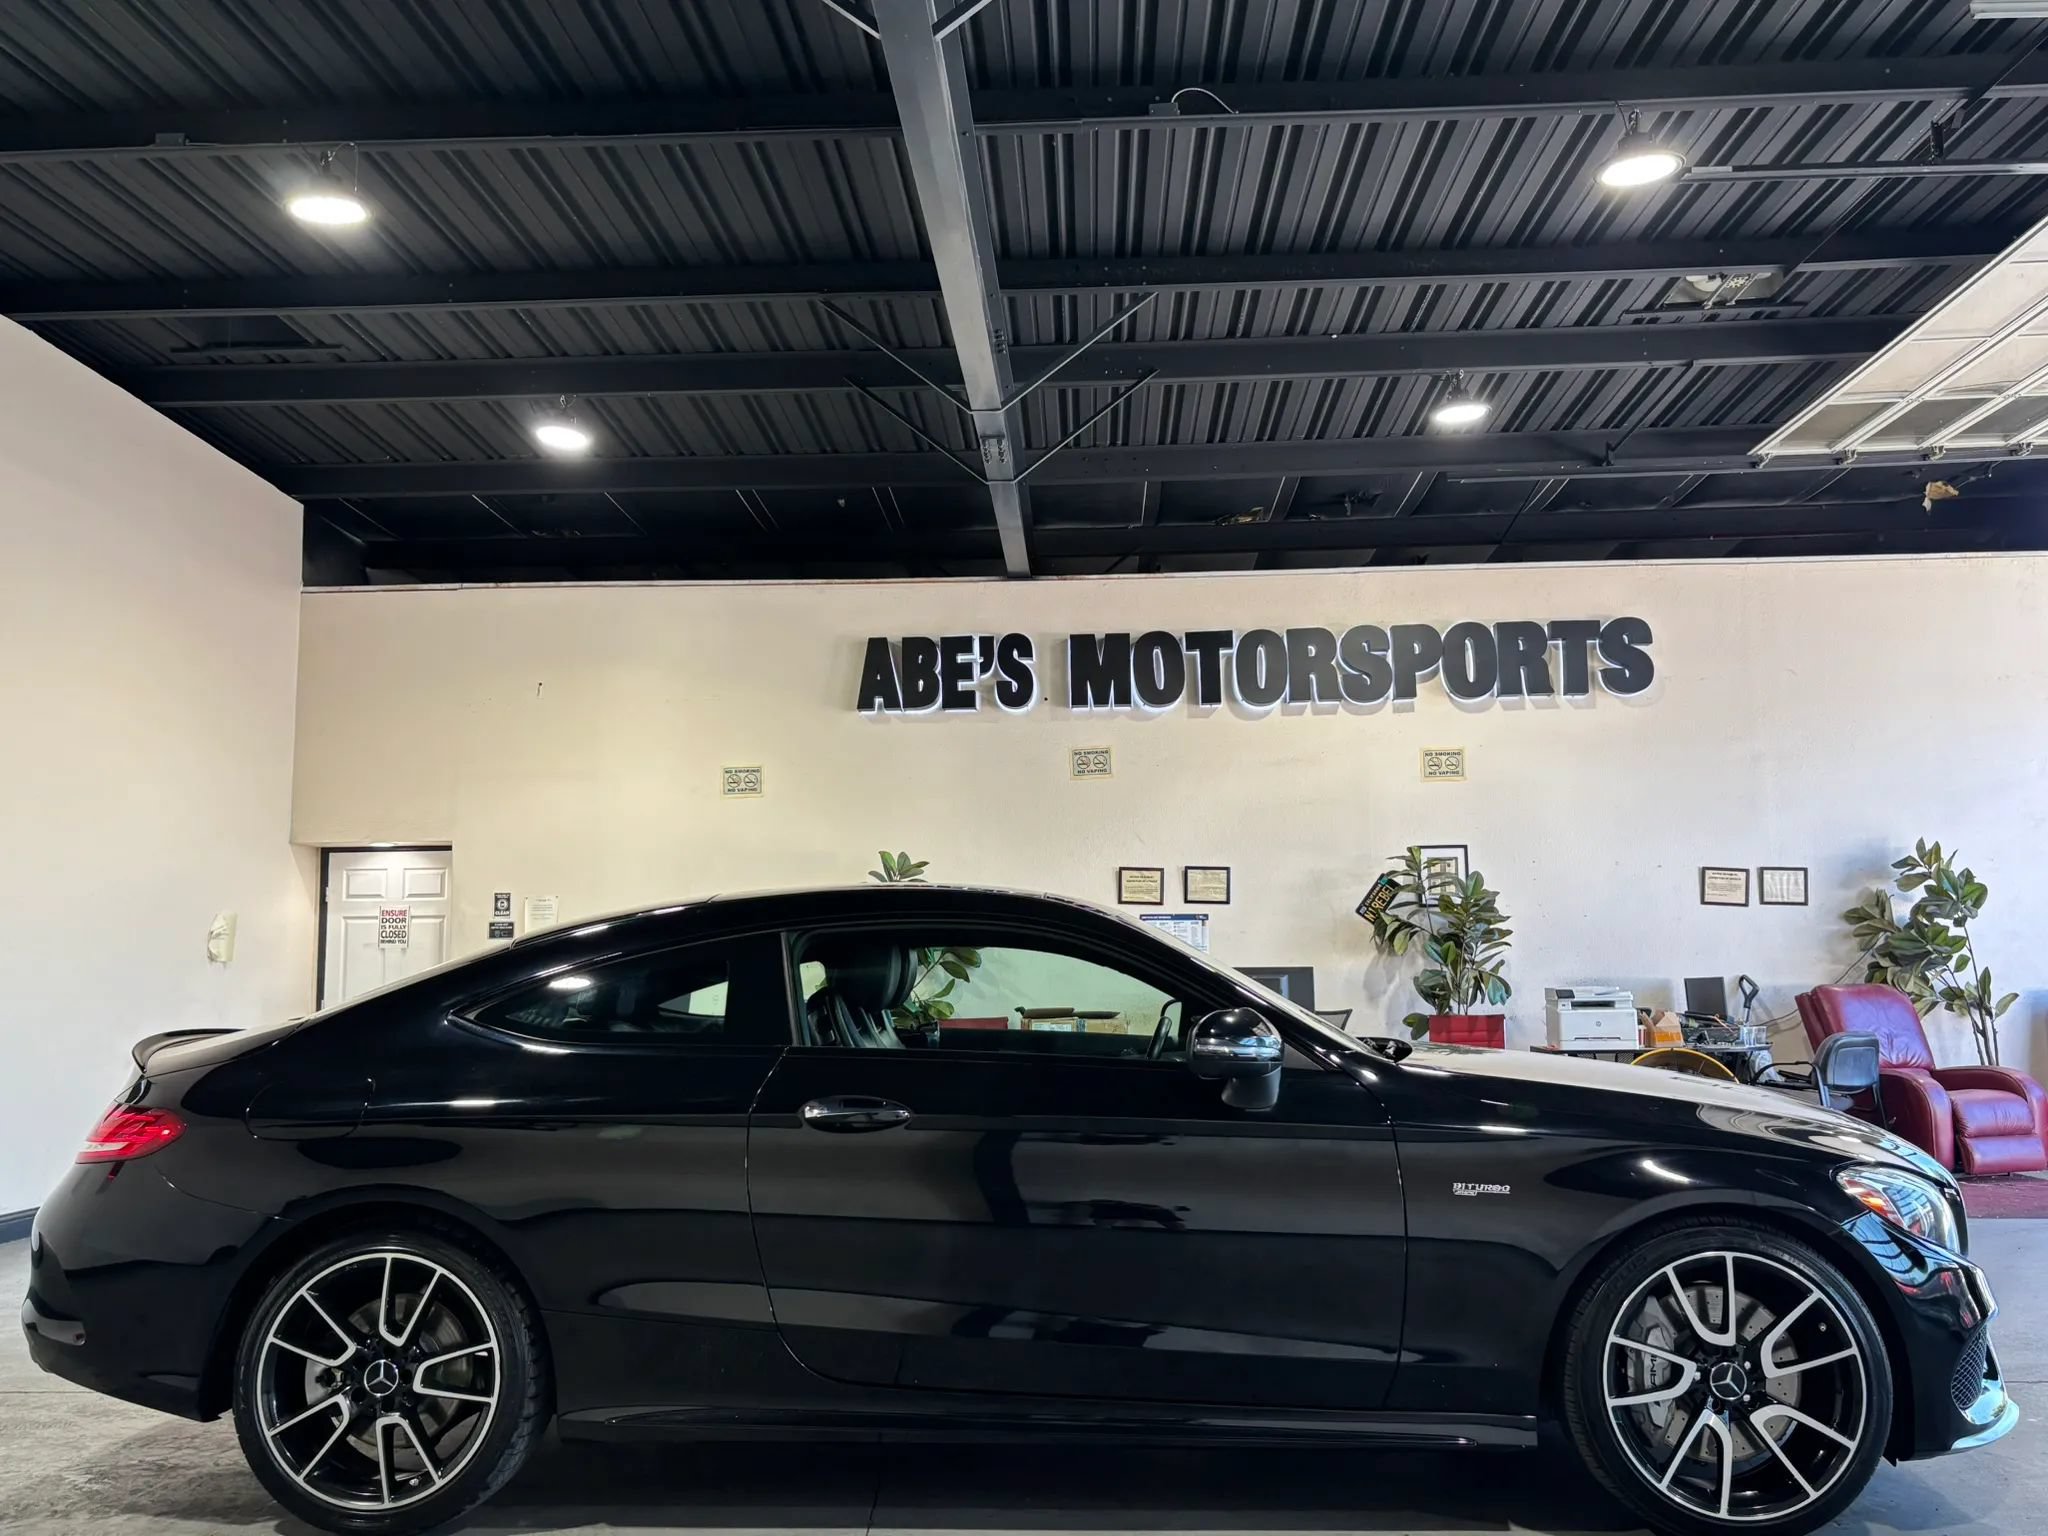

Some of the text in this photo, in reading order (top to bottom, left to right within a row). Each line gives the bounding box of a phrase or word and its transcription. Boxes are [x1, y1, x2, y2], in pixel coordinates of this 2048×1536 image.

[857, 617, 1655, 712] ABE'S MOTORSPORTS
[381, 909, 407, 917] ENSURE
[380, 930, 407, 939] CLOSED
[1453, 1182, 1511, 1193] BITURBO
